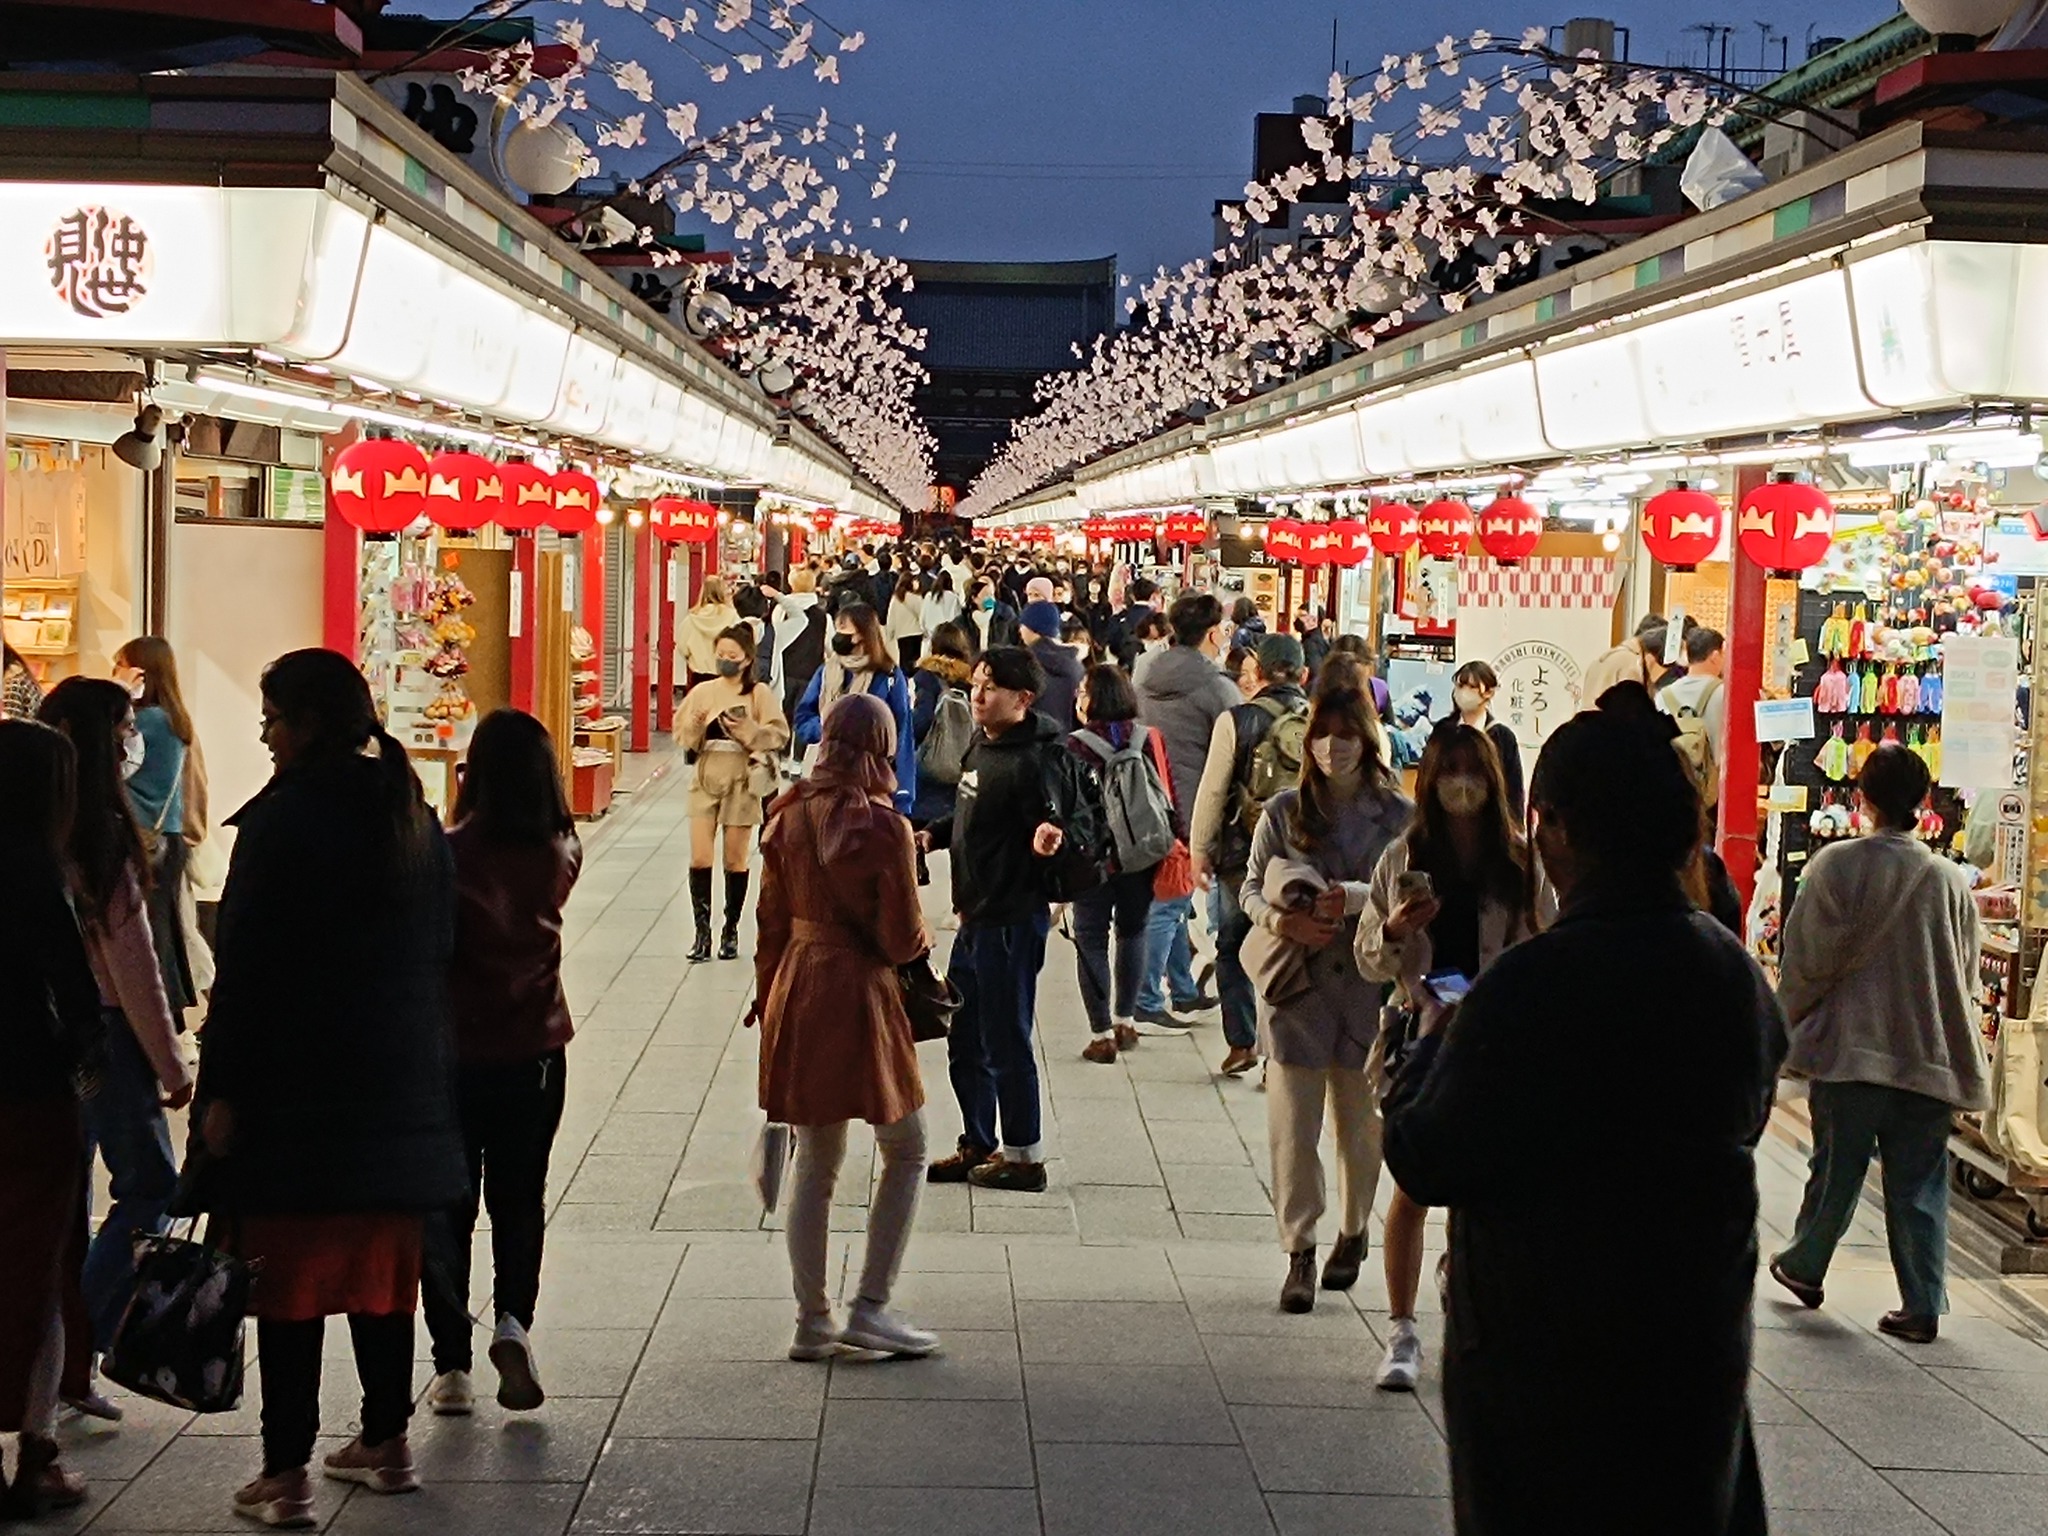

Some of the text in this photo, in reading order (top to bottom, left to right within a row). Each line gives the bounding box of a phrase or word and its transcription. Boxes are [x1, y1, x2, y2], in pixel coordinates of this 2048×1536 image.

[1494, 646, 1528, 673] OROSHI
[1531, 665, 1549, 737] よろし
